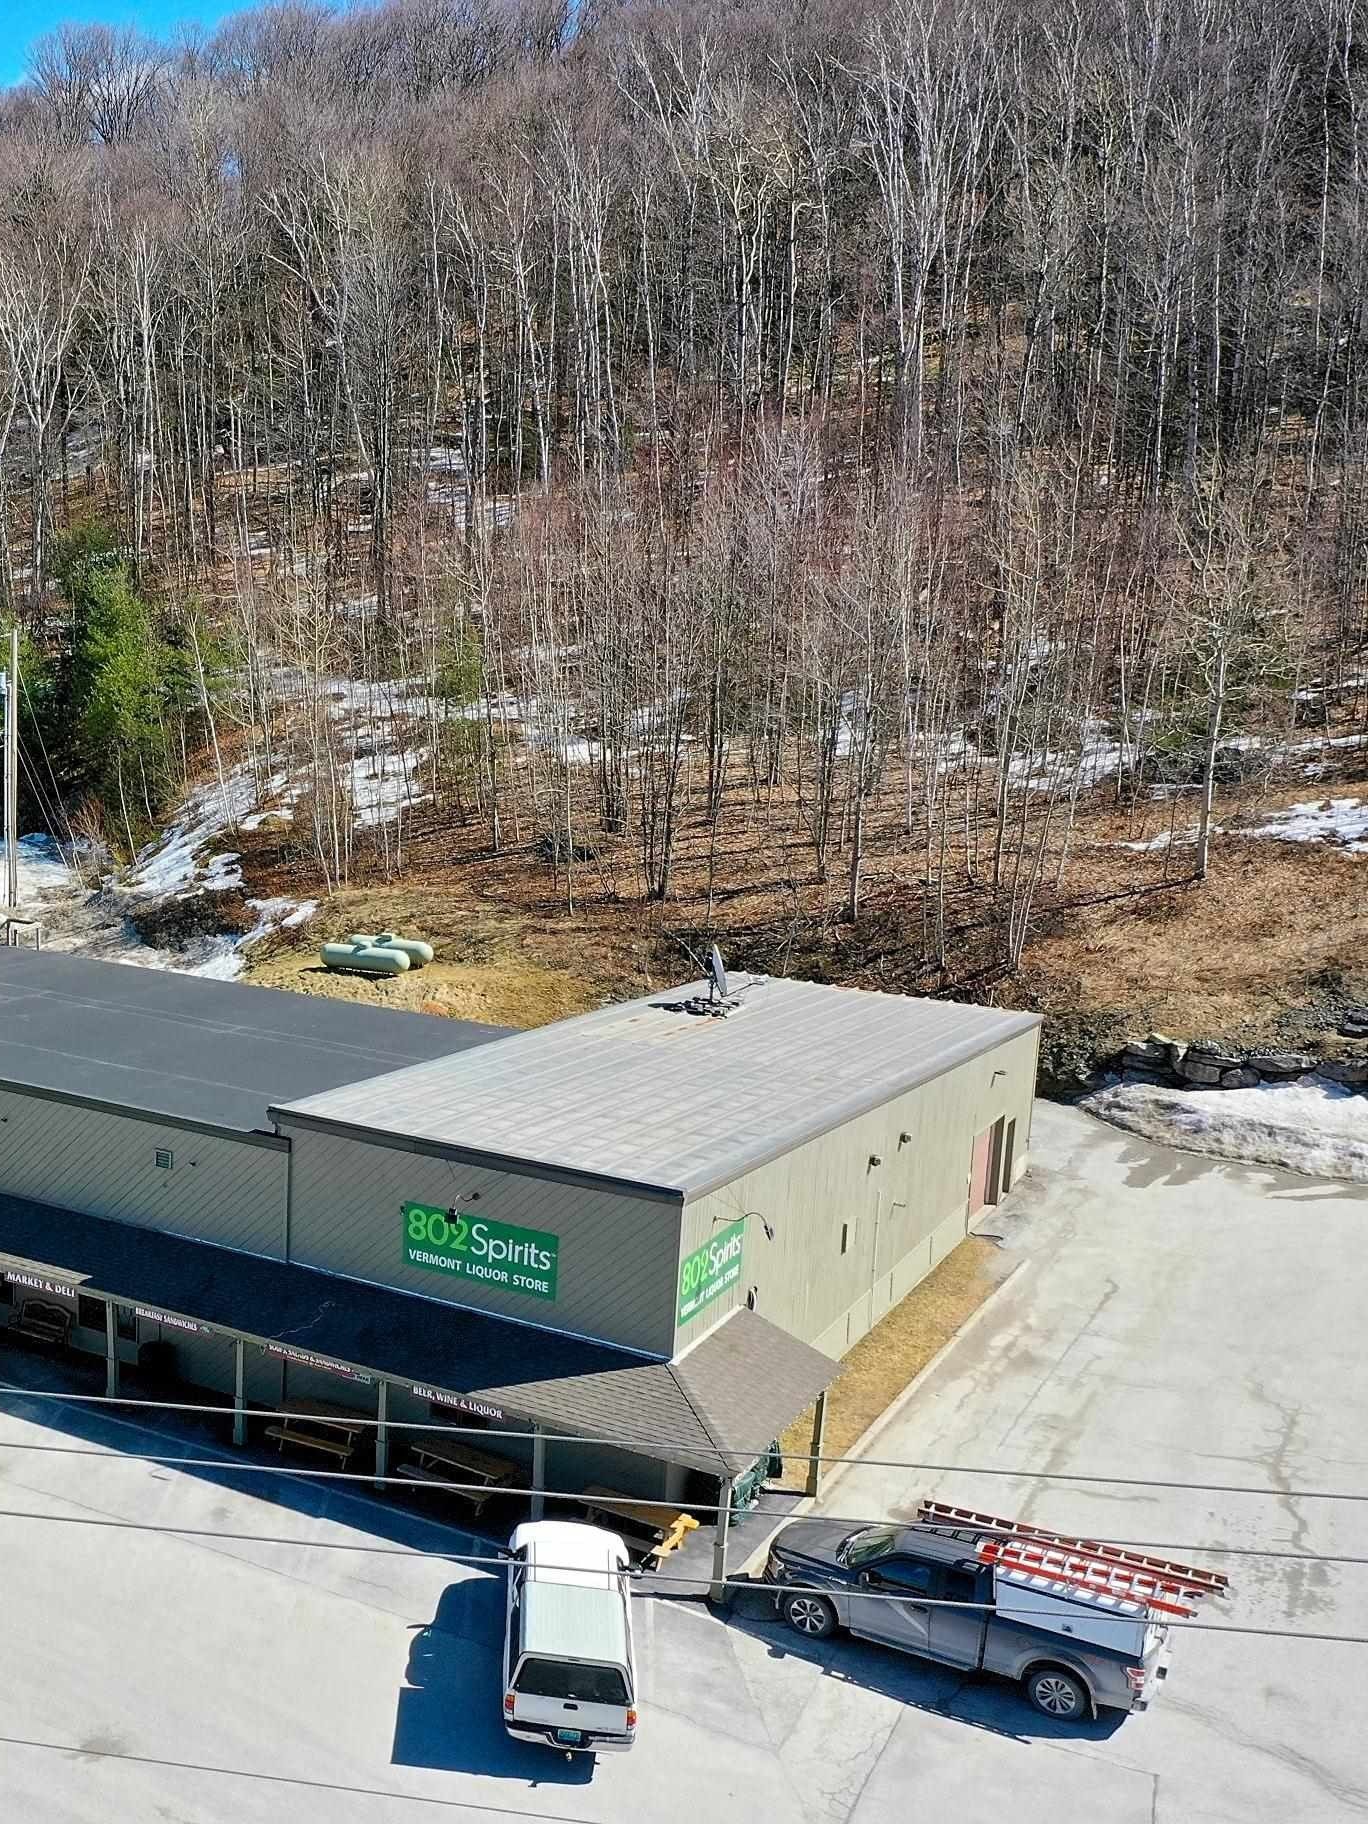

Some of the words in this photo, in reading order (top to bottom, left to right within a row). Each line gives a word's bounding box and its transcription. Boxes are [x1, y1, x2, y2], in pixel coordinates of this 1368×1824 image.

[7, 1271, 44, 1289] MARKET
[45, 1282, 54, 1292] &
[55, 1285, 75, 1298] DELI
[409, 1249, 463, 1272] VERMONT
[466, 1262, 509, 1284] LIQUOR
[513, 1273, 550, 1294] STORE
[436, 1392, 458, 1406] WINE
[460, 1400, 468, 1409] &
[469, 1401, 503, 1419] LIQUOR
